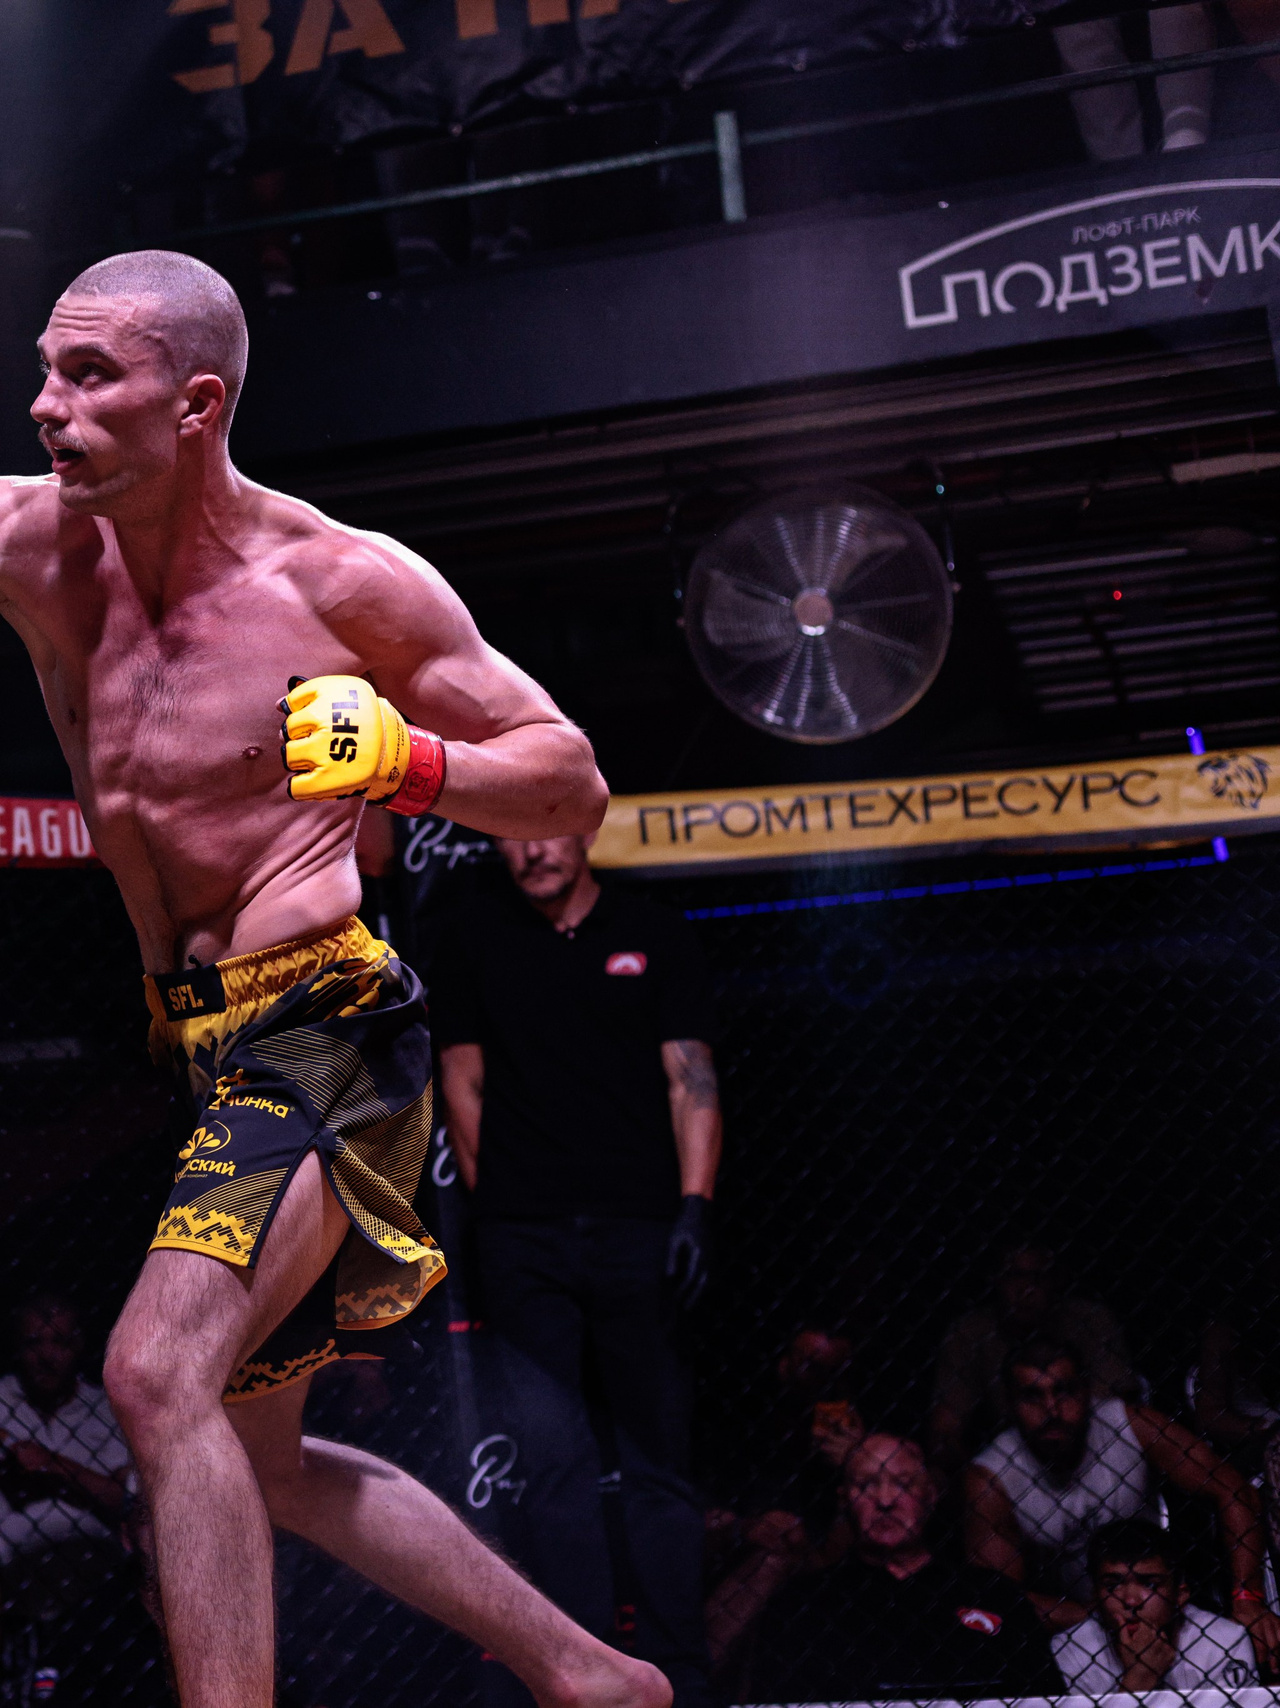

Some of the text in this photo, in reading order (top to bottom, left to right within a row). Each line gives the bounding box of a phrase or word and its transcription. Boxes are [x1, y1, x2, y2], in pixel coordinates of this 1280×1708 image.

[1071, 205, 1202, 245] ЛОФТ-ПАРК
[329, 689, 359, 763] SFL
[636, 767, 1161, 846] ПРОМТЕХРЕСУРС
[168, 983, 205, 1012] SFL
